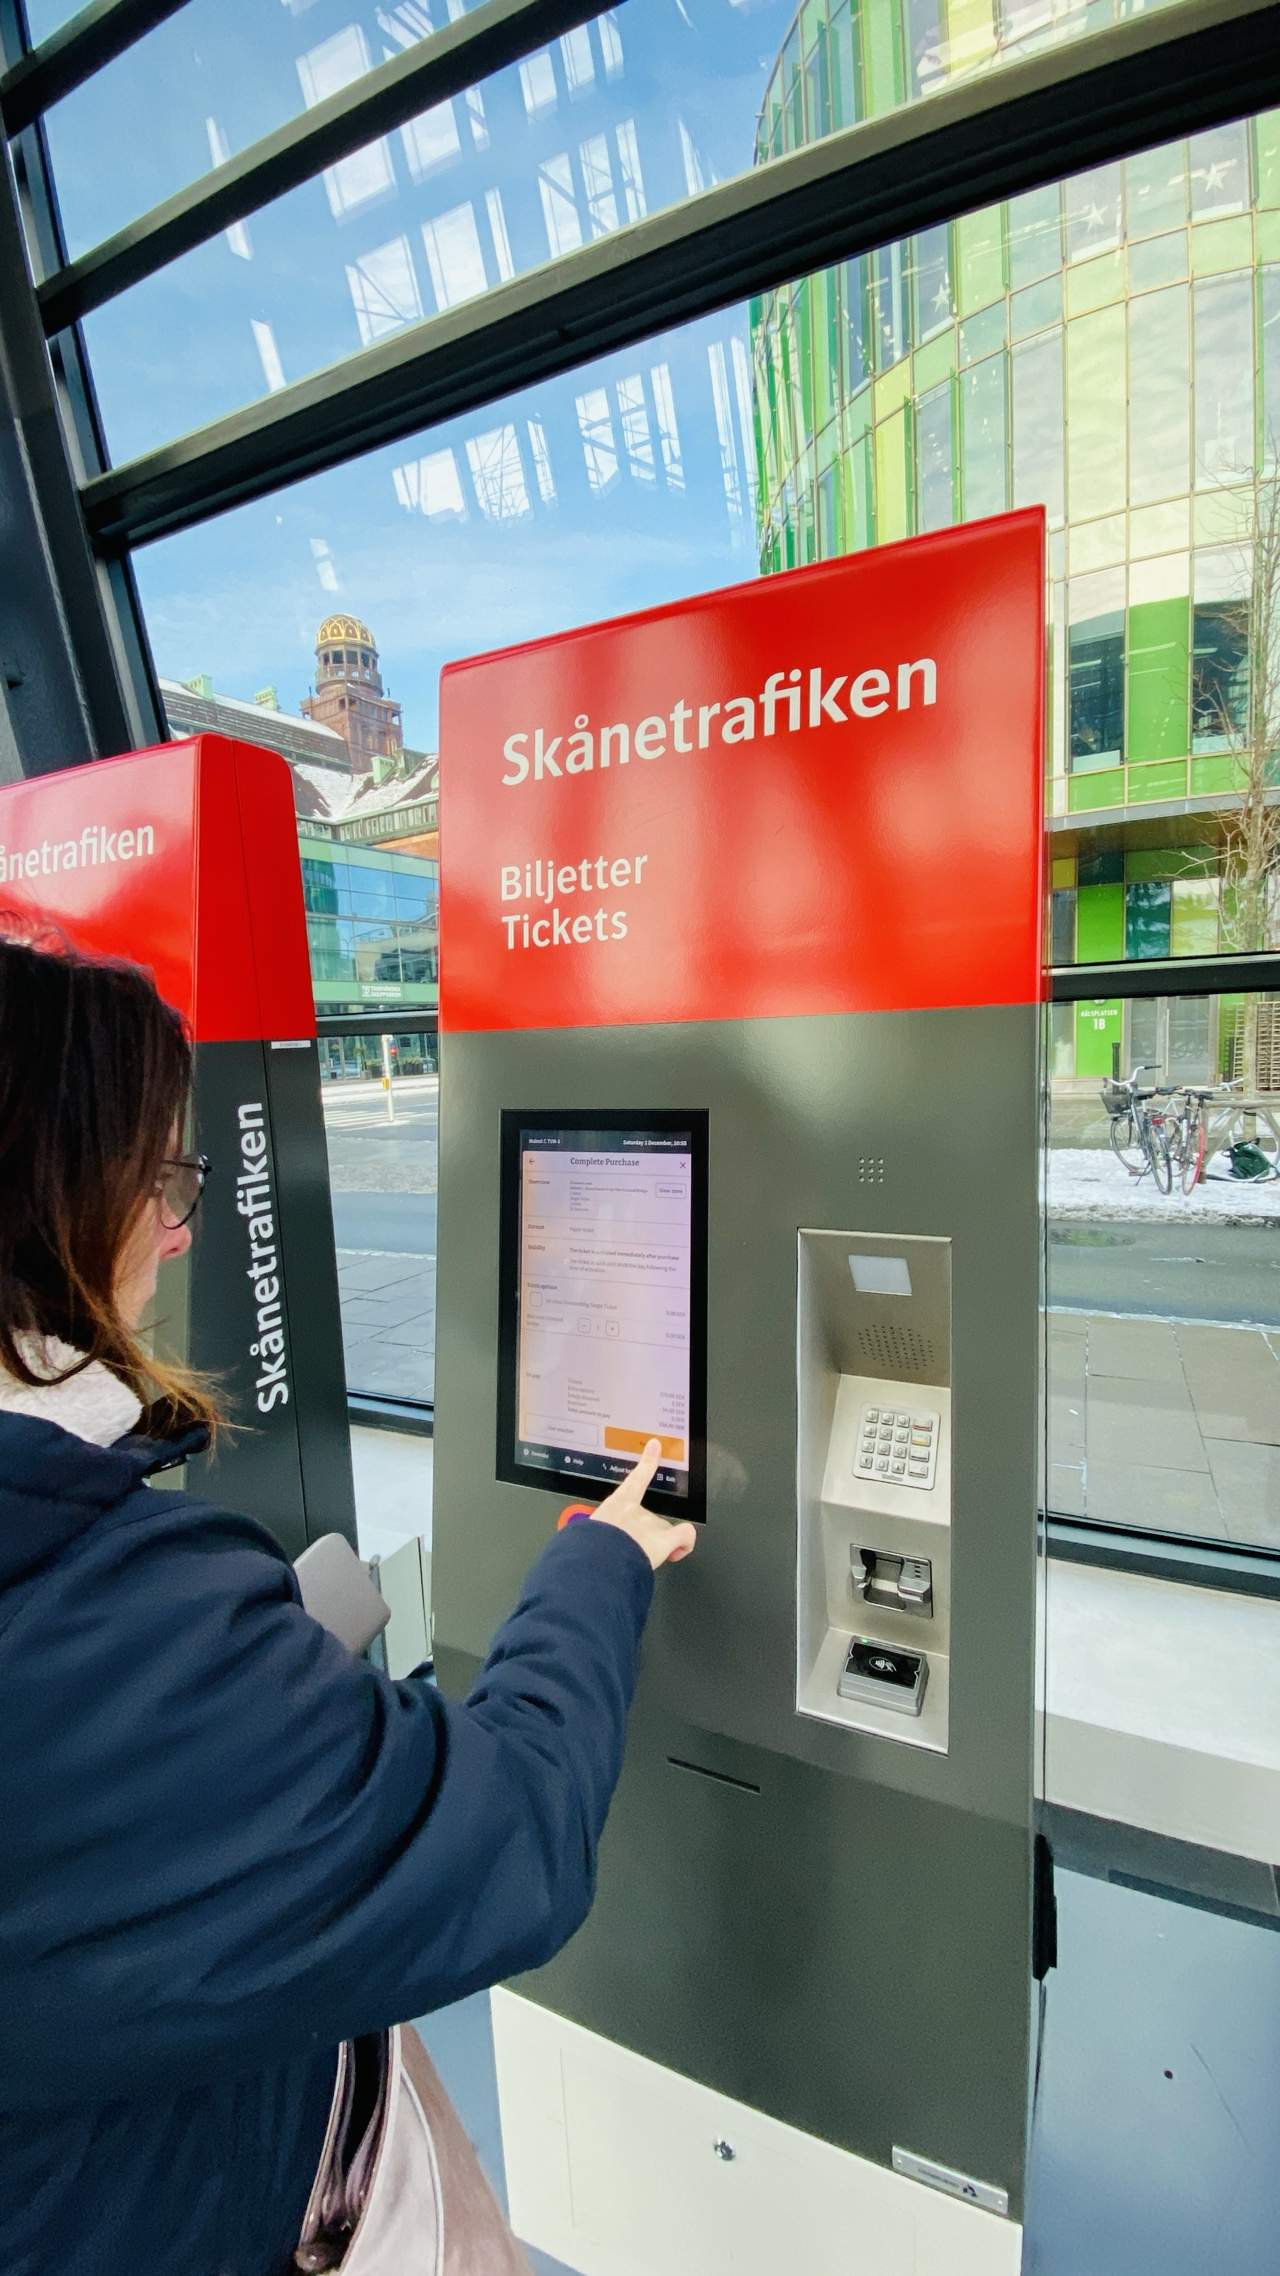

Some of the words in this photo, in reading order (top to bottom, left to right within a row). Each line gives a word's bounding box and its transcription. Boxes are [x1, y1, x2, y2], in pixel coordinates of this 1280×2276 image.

[502, 657, 937, 786] Skånetrafiken
[501, 854, 648, 903] Biljetter
[502, 908, 628, 950] Tickets
[570, 1157, 604, 1167] Complete
[605, 1158, 640, 1166] Purchase
[237, 1102, 289, 1413] Skånetrafiken
